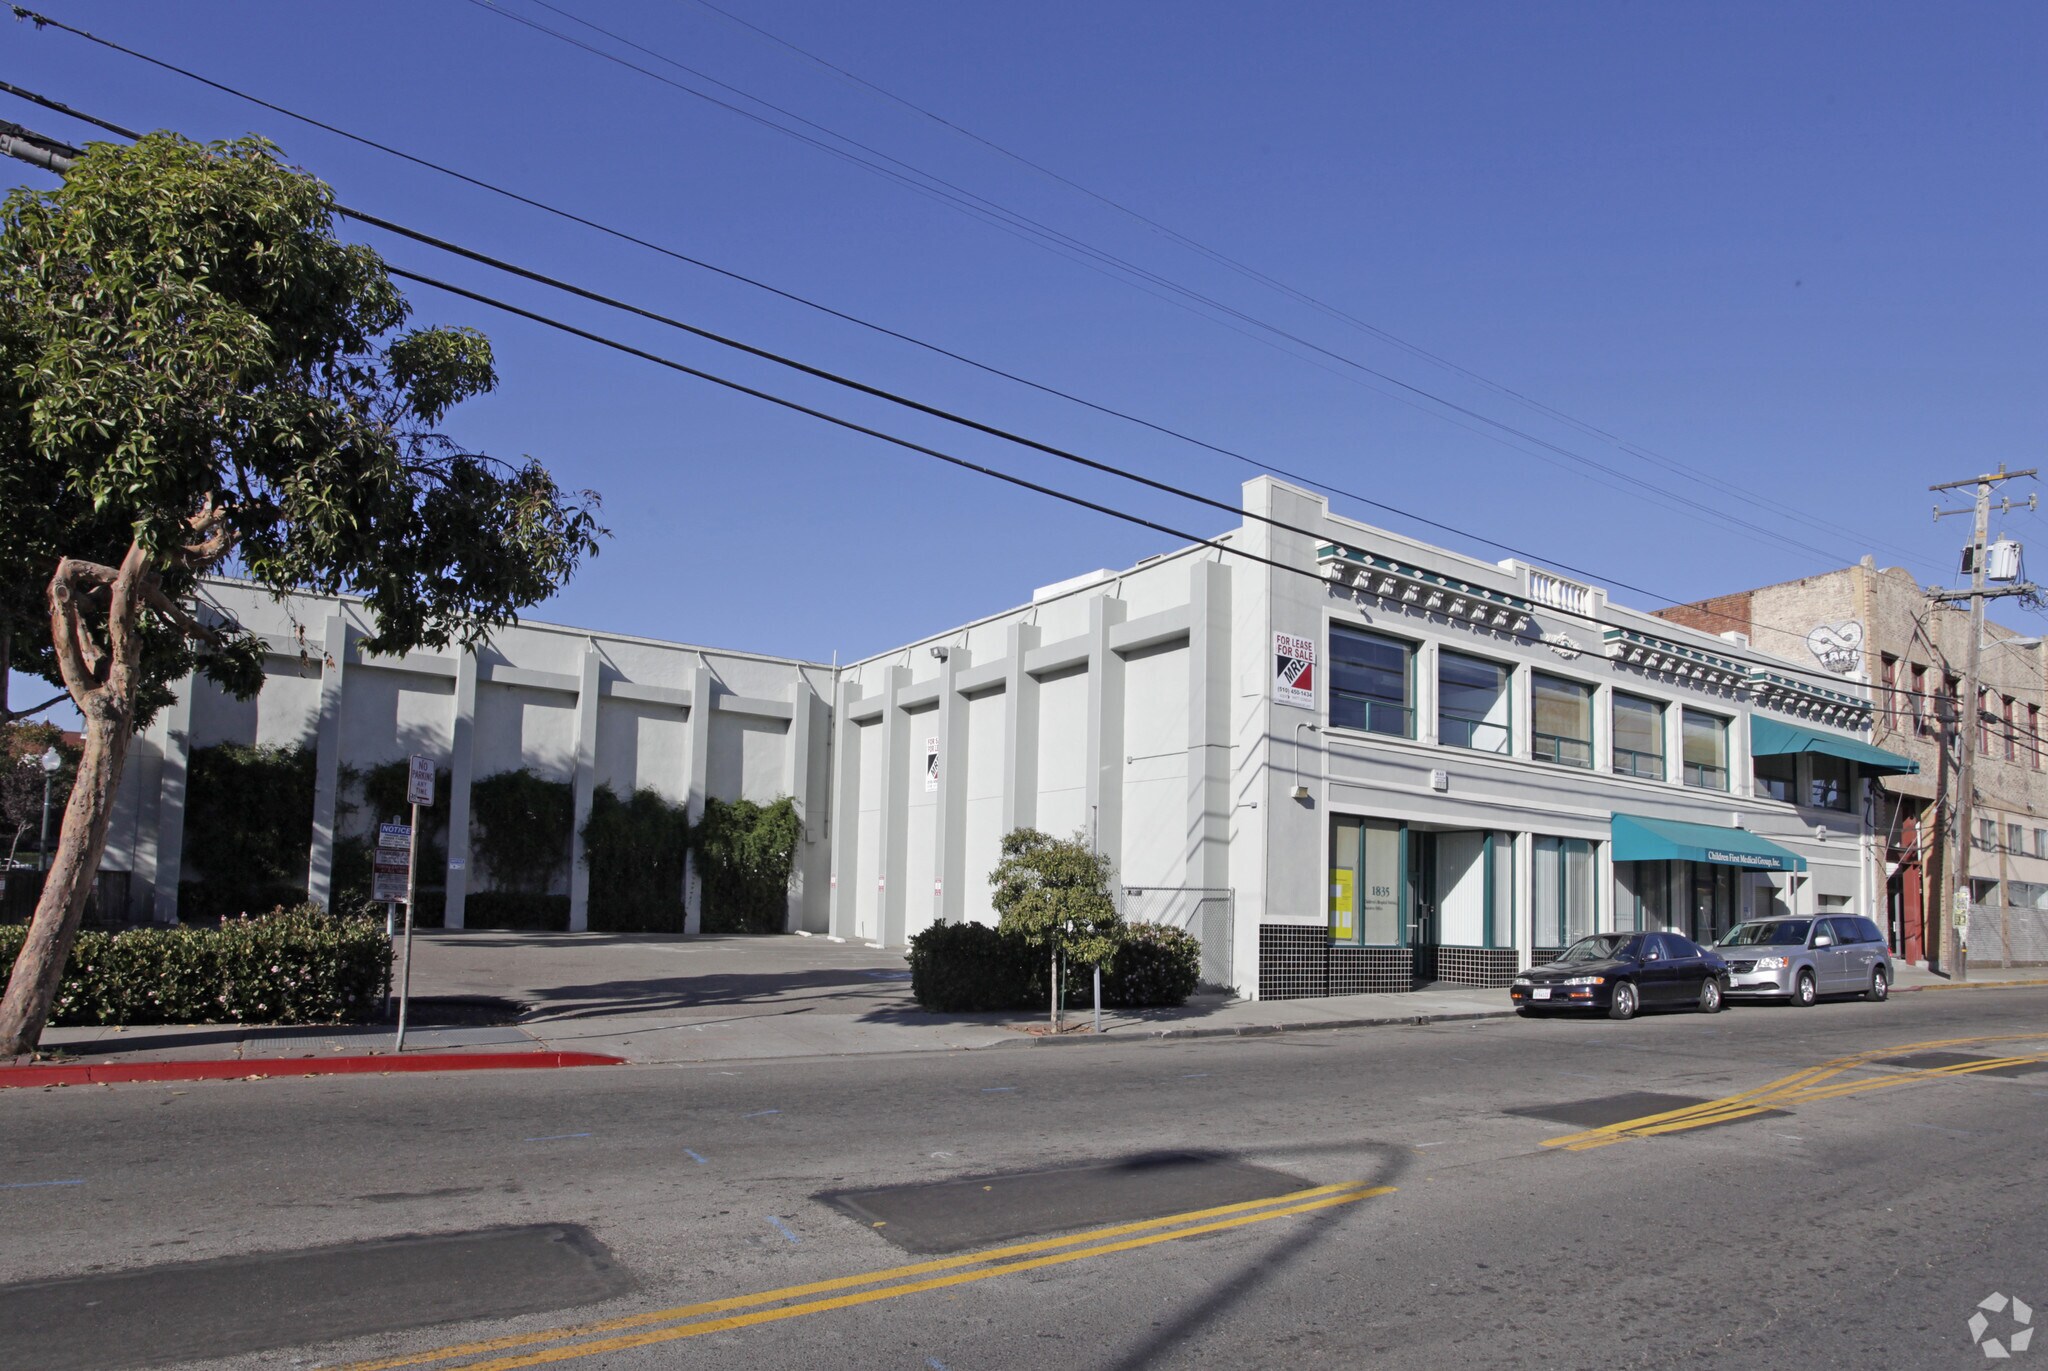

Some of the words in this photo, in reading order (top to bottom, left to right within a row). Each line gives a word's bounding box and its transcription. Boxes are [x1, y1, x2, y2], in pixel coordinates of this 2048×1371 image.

[1276, 635, 1290, 646] FOR
[1292, 639, 1312, 652] LEASE
[1277, 645, 1292, 657] FOR
[1294, 649, 1313, 661] SALE
[418, 759, 428, 771] NO
[411, 769, 433, 782] PARKING
[416, 787, 427, 795] TIME
[381, 825, 411, 835] NOTICE
[1708, 850, 1729, 862] Children
[1729, 853, 1740, 862] First
[1740, 854, 1757, 864] Medical
[1371, 886, 1390, 897] 1835
